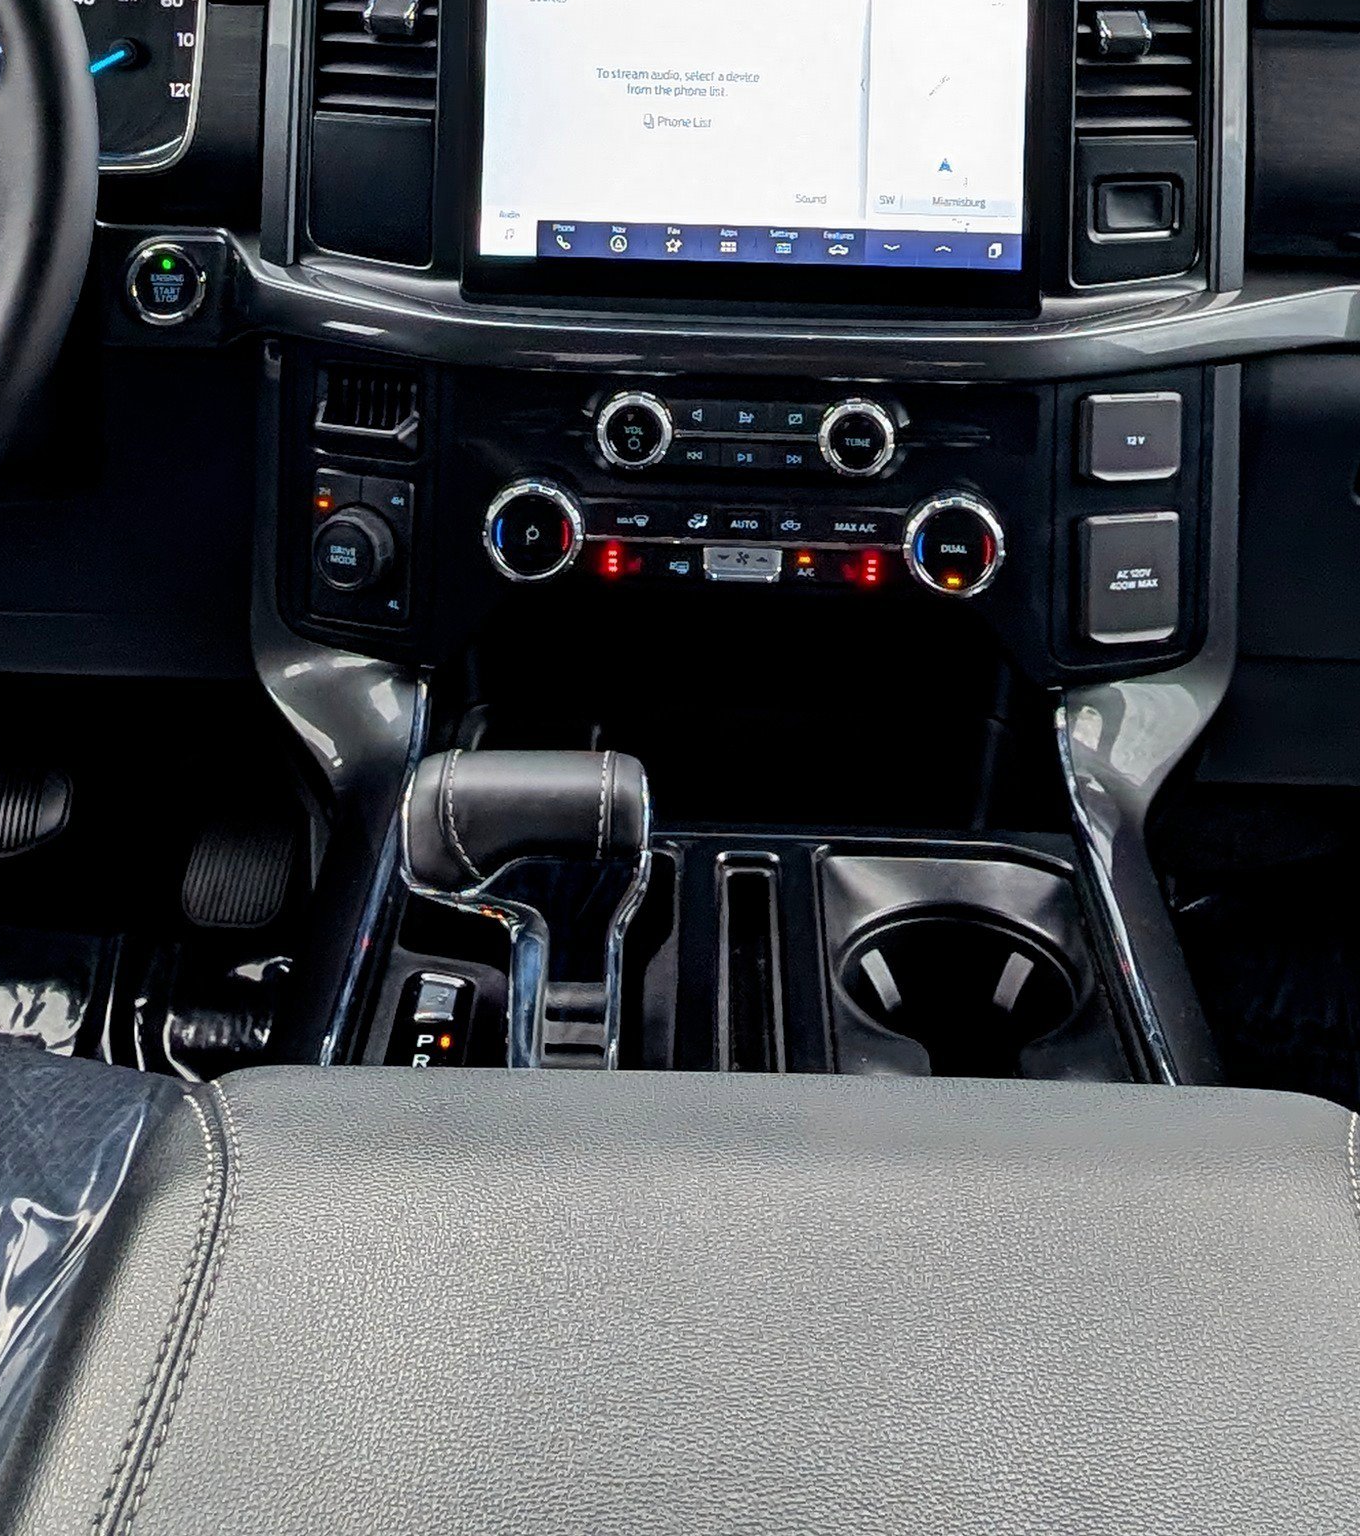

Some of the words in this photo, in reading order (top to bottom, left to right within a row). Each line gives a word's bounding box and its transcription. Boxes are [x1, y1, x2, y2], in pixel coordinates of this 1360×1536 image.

[596, 67, 610, 79] To
[611, 68, 649, 80] stream
[650, 69, 683, 82] audio,
[684, 70, 715, 82] select
[726, 71, 760, 83] device
[627, 83, 652, 95] from
[654, 84, 672, 96] the
[674, 85, 707, 97] phone
[709, 86, 729, 97] list.
[657, 115, 692, 127] Phone
[693, 117, 712, 128] List
[795, 194, 828, 204] Sound
[879, 195, 896, 205] SW
[552, 224, 576, 233] Phone
[720, 229, 738, 238] Apps
[769, 229, 798, 239] Settings
[823, 231, 855, 240] Features
[153, 286, 180, 296] START
[154, 295, 179, 304] STOP
[844, 437, 871, 448] TUNE
[730, 519, 758, 530] AUTO
[834, 521, 857, 532] MAX
[858, 521, 878, 534] A/C
[940, 543, 968, 554] DUAL
[330, 554, 357, 566] MODE
[797, 567, 816, 579] A/C
[1138, 578, 1159, 589] MAX
[417, 1035, 434, 1048] P
[412, 1054, 429, 1067] R
